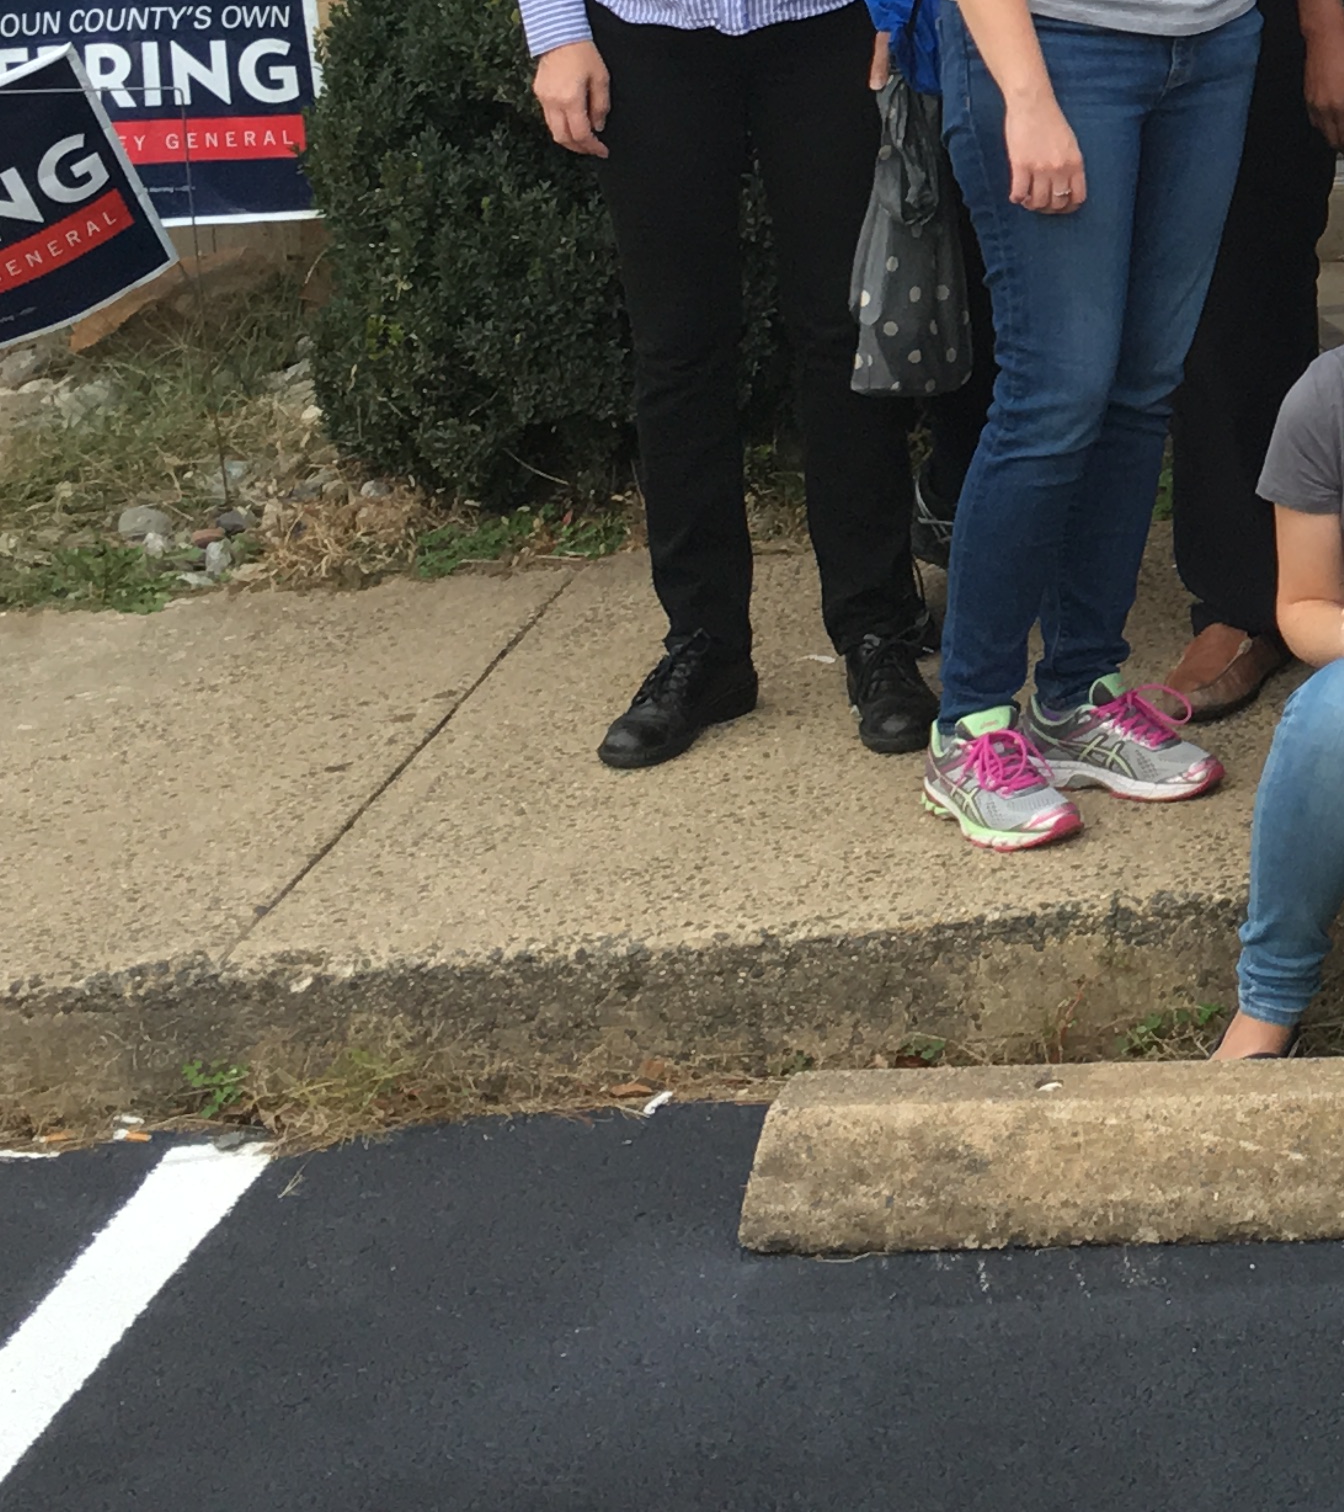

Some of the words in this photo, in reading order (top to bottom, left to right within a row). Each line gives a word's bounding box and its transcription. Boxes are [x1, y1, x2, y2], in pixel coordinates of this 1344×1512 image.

[69, 5, 213, 34] COUNTY'S
[221, 5, 291, 30] OWN
[165, 129, 295, 151] GENERAL
[0, 211, 117, 282] ENERAL
